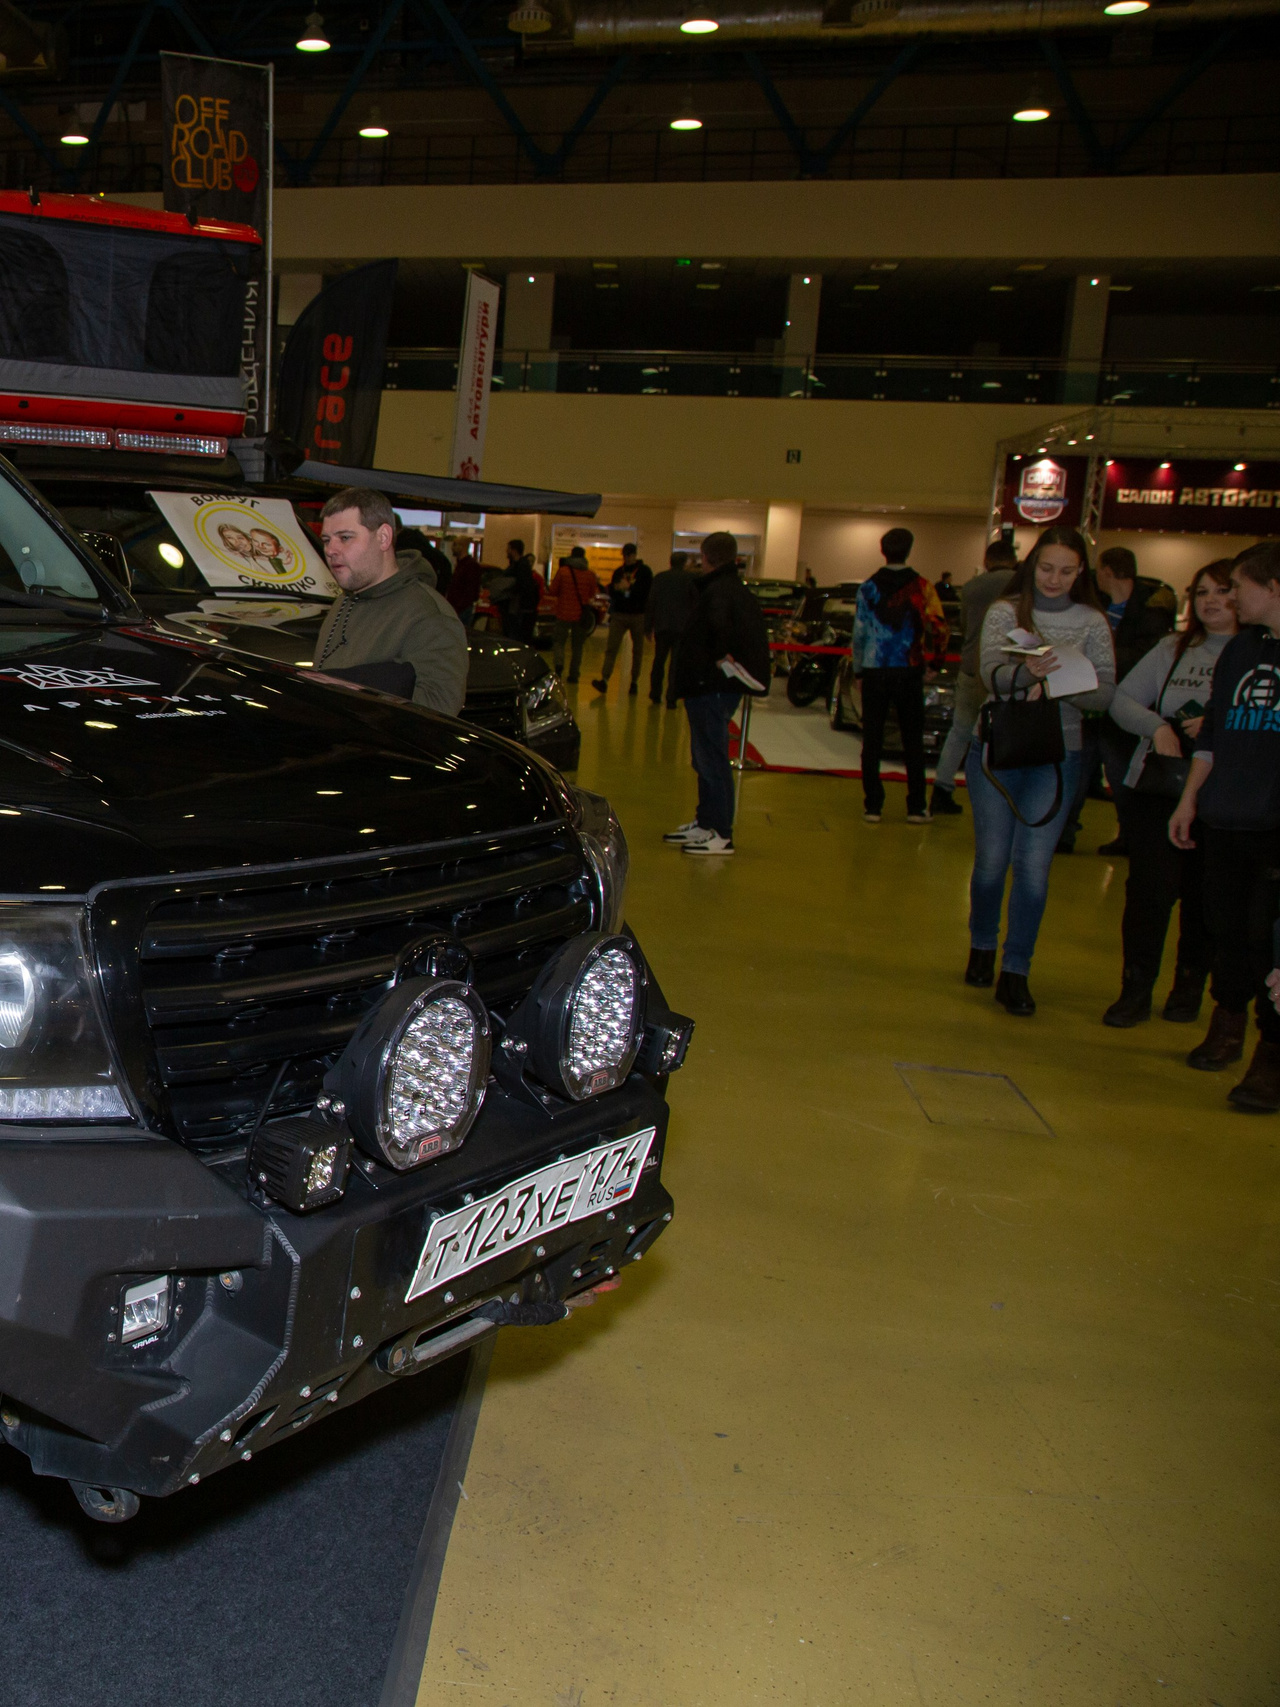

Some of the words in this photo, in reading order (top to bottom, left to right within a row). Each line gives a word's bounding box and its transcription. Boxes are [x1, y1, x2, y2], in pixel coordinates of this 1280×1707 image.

[175, 94, 231, 128] OFF
[172, 124, 248, 162] ROAD
[171, 155, 233, 191] CLUB
[304, 333, 354, 465] race
[1117, 488, 1174, 504] САЛОН
[1169, 679, 1204, 688] NEW
[594, 1074, 609, 1089] ARB
[421, 1139, 440, 1156] ARB
[586, 1186, 615, 1209] RUS
